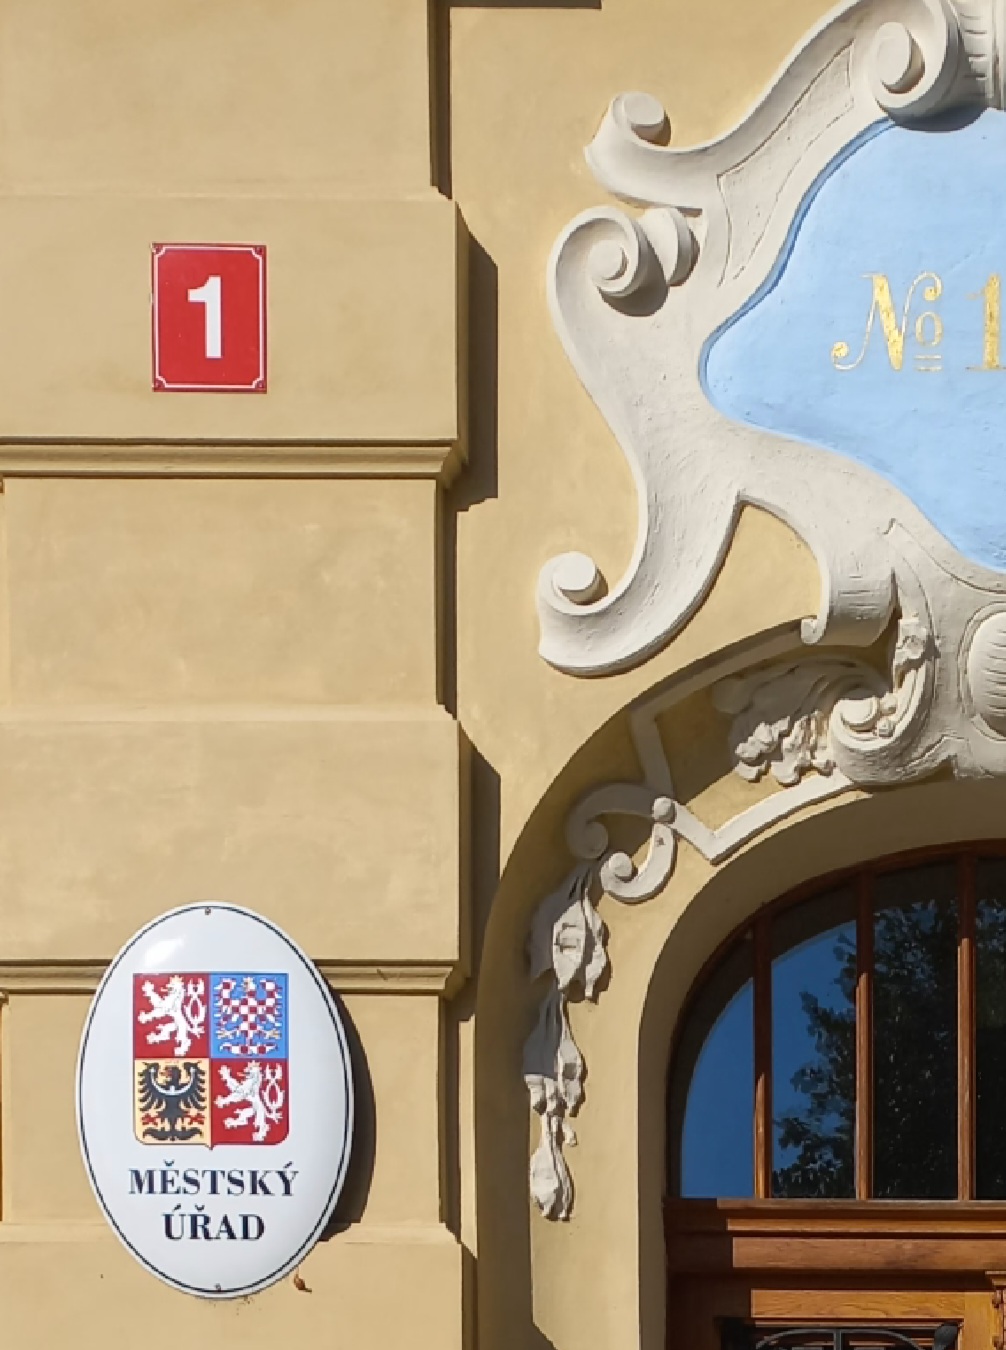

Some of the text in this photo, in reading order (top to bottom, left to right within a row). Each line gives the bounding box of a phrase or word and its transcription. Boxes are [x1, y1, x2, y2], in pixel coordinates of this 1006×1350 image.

[187, 274, 223, 359] 1
[128, 1159, 300, 1197] MĚSTSKÝ
[162, 1203, 265, 1241] ÚŘAD
